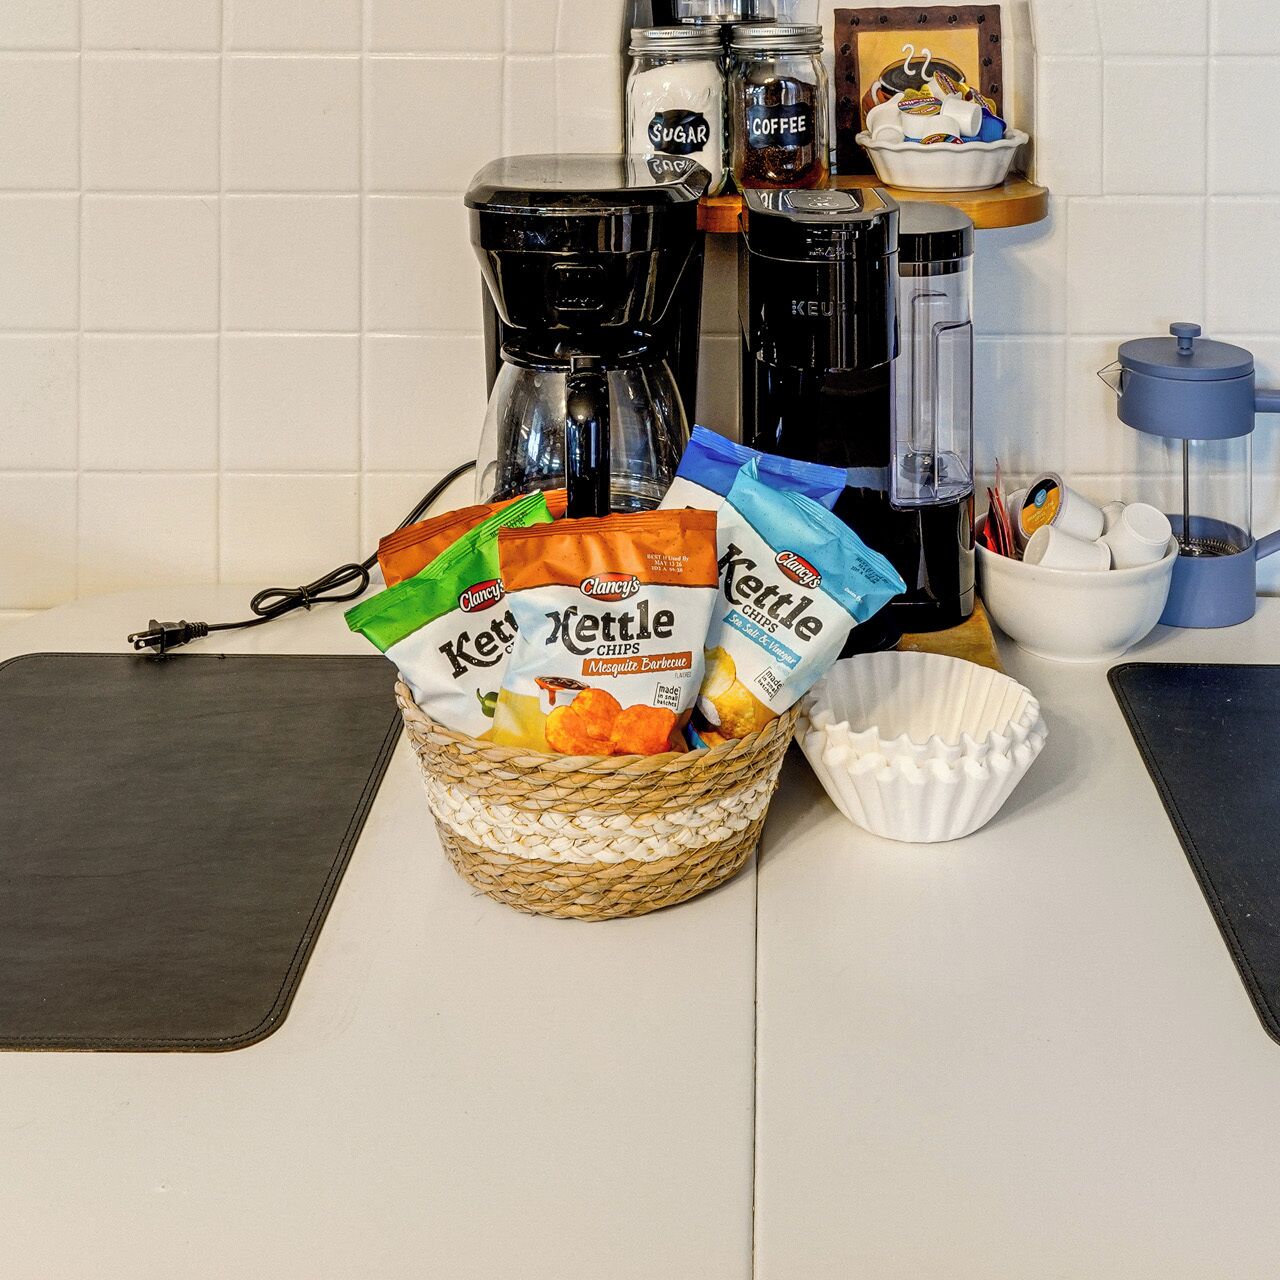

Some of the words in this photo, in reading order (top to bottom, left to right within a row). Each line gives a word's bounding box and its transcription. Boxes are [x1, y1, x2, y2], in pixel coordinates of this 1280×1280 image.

[650, 124, 707, 144] SUGAR
[752, 115, 807, 135] COFFEE
[775, 551, 822, 589] Clancy's
[459, 579, 505, 612] Clancy's
[579, 576, 641, 598] Clancy's
[717, 543, 824, 642] Kettle
[545, 600, 675, 656] Kettle
[742, 604, 779, 634] CHIPS
[438, 609, 519, 679] Kett
[597, 642, 640, 656] CHIPS
[728, 614, 743, 628] Sea
[742, 623, 760, 639] Salt
[768, 641, 797, 664] Vinegar
[588, 660, 639, 678] Mesquite
[641, 656, 688, 671] Barbecue
[765, 670, 783, 690] made
[659, 685, 679, 696] made
